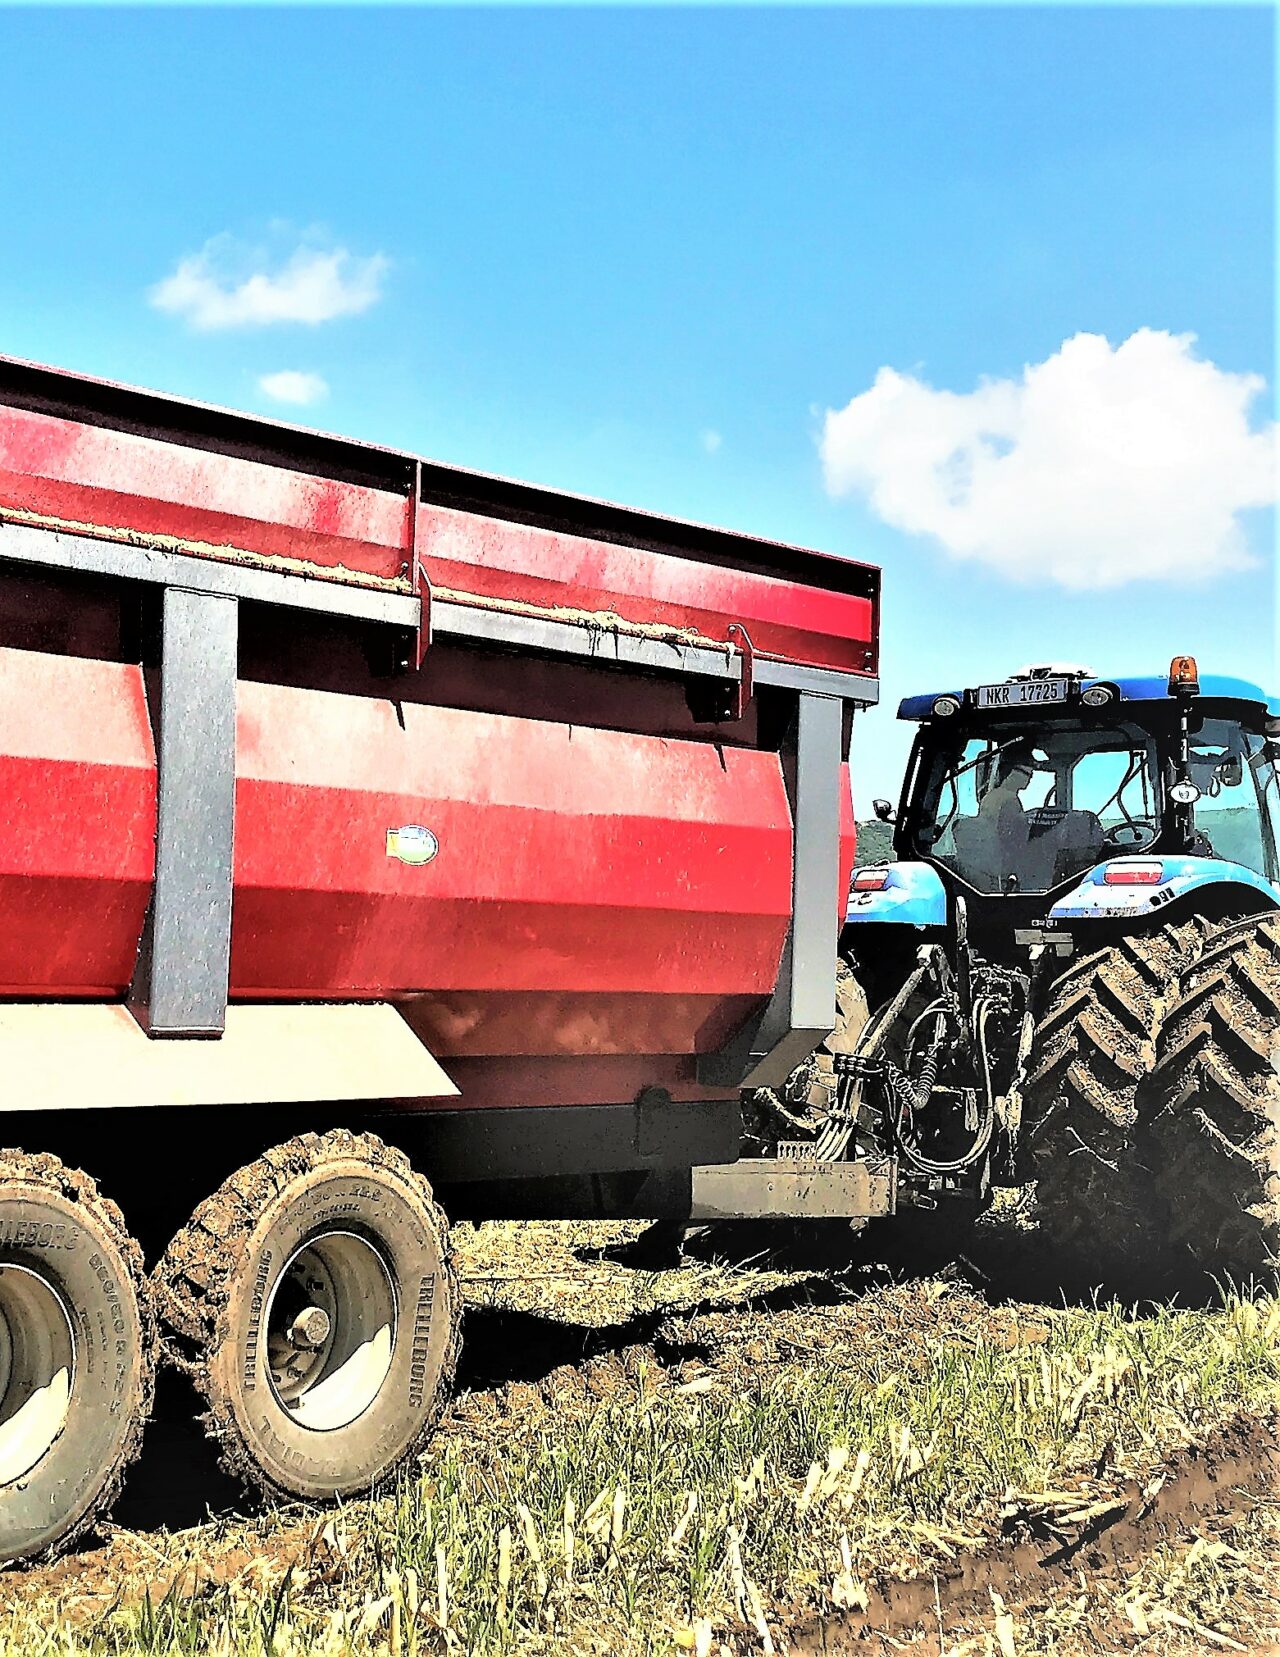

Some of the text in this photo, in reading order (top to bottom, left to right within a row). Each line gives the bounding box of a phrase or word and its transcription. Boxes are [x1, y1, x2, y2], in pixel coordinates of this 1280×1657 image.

[986, 682, 1058, 705] NKR 17725
[244, 1249, 273, 1391] TRELLEBORG
[408, 1272, 436, 1409] TRELLEBORG
